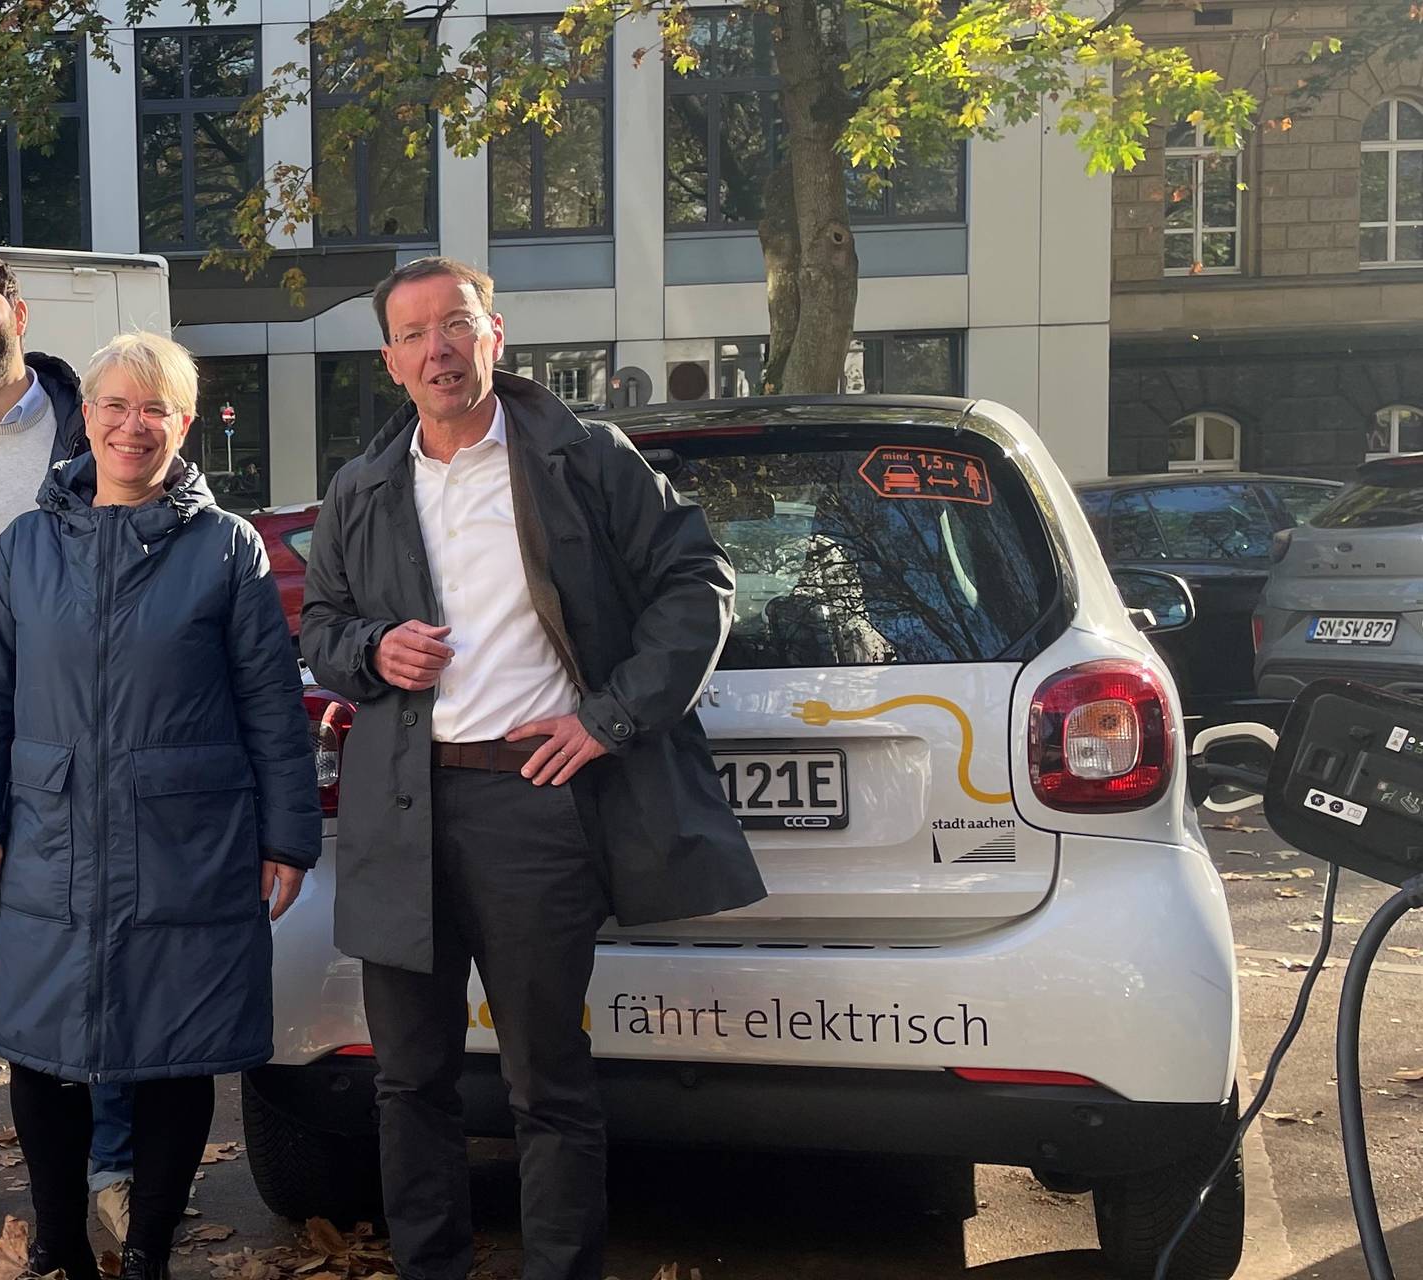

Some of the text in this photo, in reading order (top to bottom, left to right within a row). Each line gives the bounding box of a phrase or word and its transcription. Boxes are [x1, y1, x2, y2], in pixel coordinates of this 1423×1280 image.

[882, 451, 913, 461] mind.
[918, 453, 944, 471] 1,5
[1316, 620, 1337, 637] SN
[1363, 621, 1394, 639] 879
[717, 760, 838, 809] 121E
[932, 816, 1016, 829] stadt aachen
[608, 993, 729, 1038] fährt
[744, 998, 989, 1047] elektrisch
